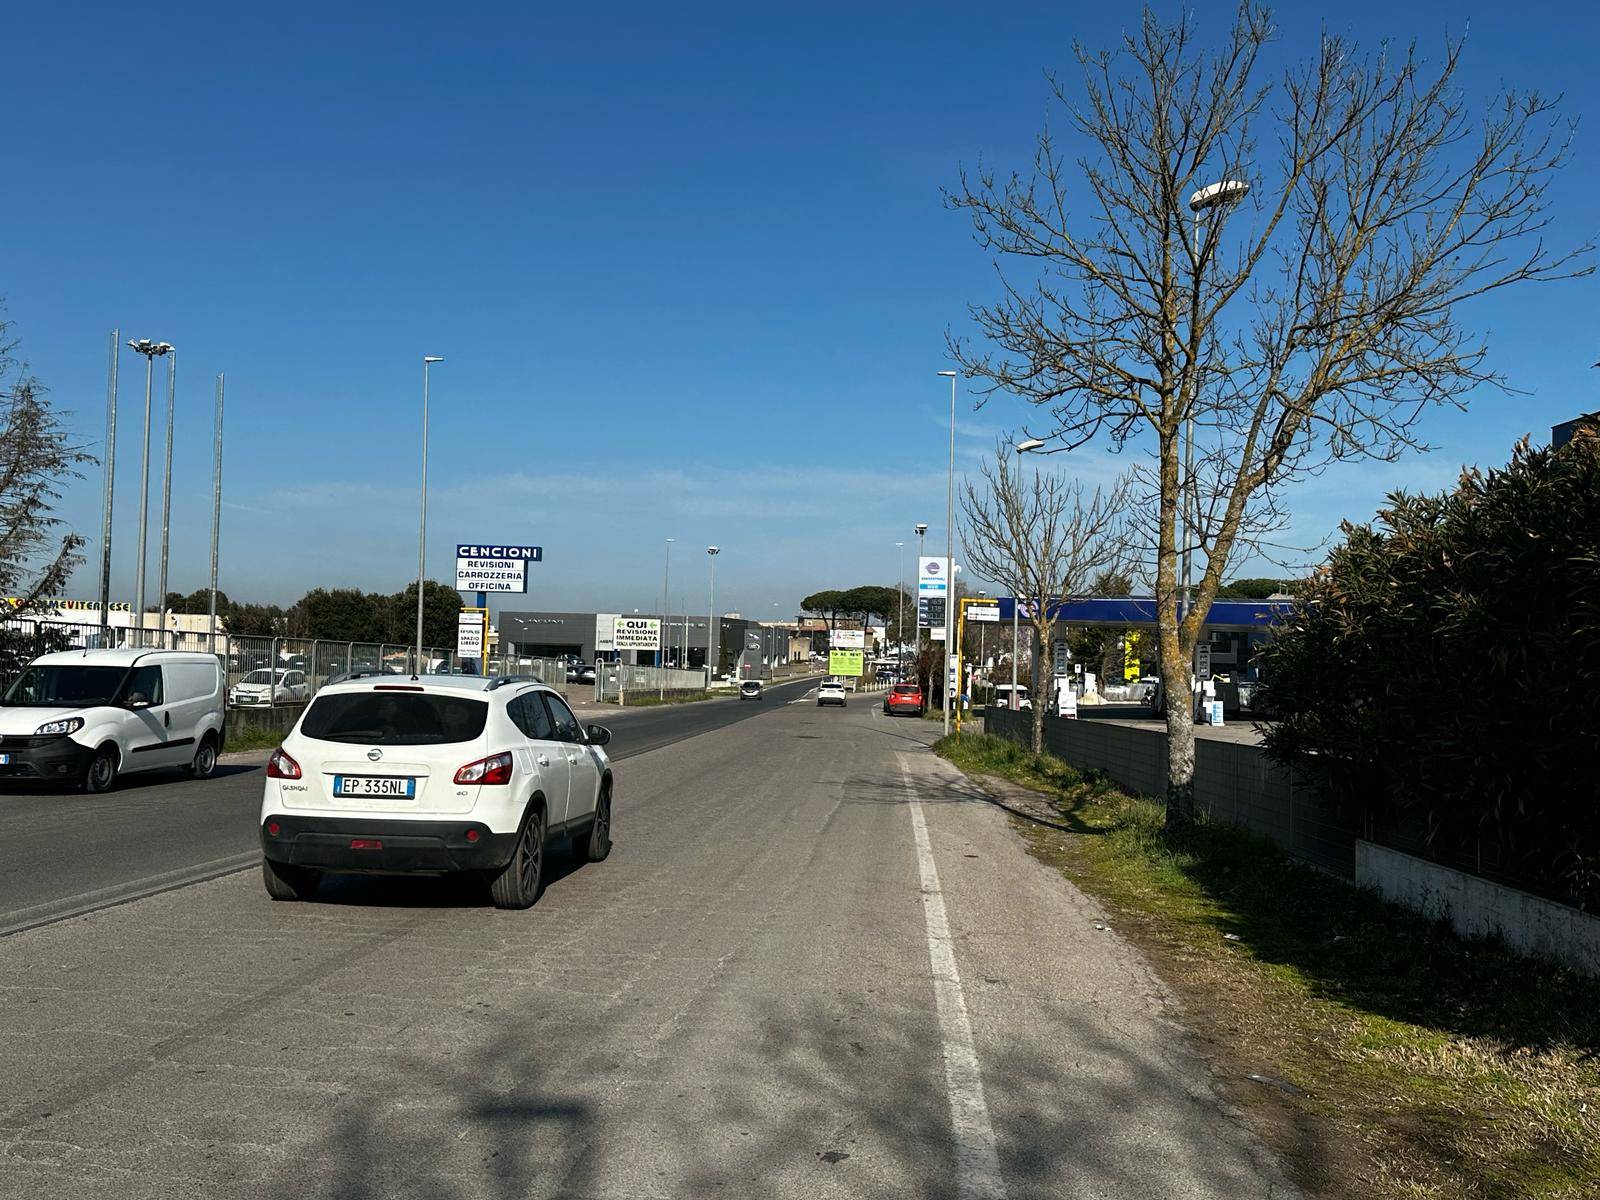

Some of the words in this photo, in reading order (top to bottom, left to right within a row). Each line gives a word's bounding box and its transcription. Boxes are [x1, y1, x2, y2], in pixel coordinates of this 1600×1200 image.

[459, 546, 537, 558] CENCIONI
[467, 560, 514, 569] REVISIONI
[458, 571, 522, 580] CARROZZERIA
[468, 582, 511, 590] OFFICINA
[343, 778, 360, 793] EP
[364, 779, 405, 795] 335NL
